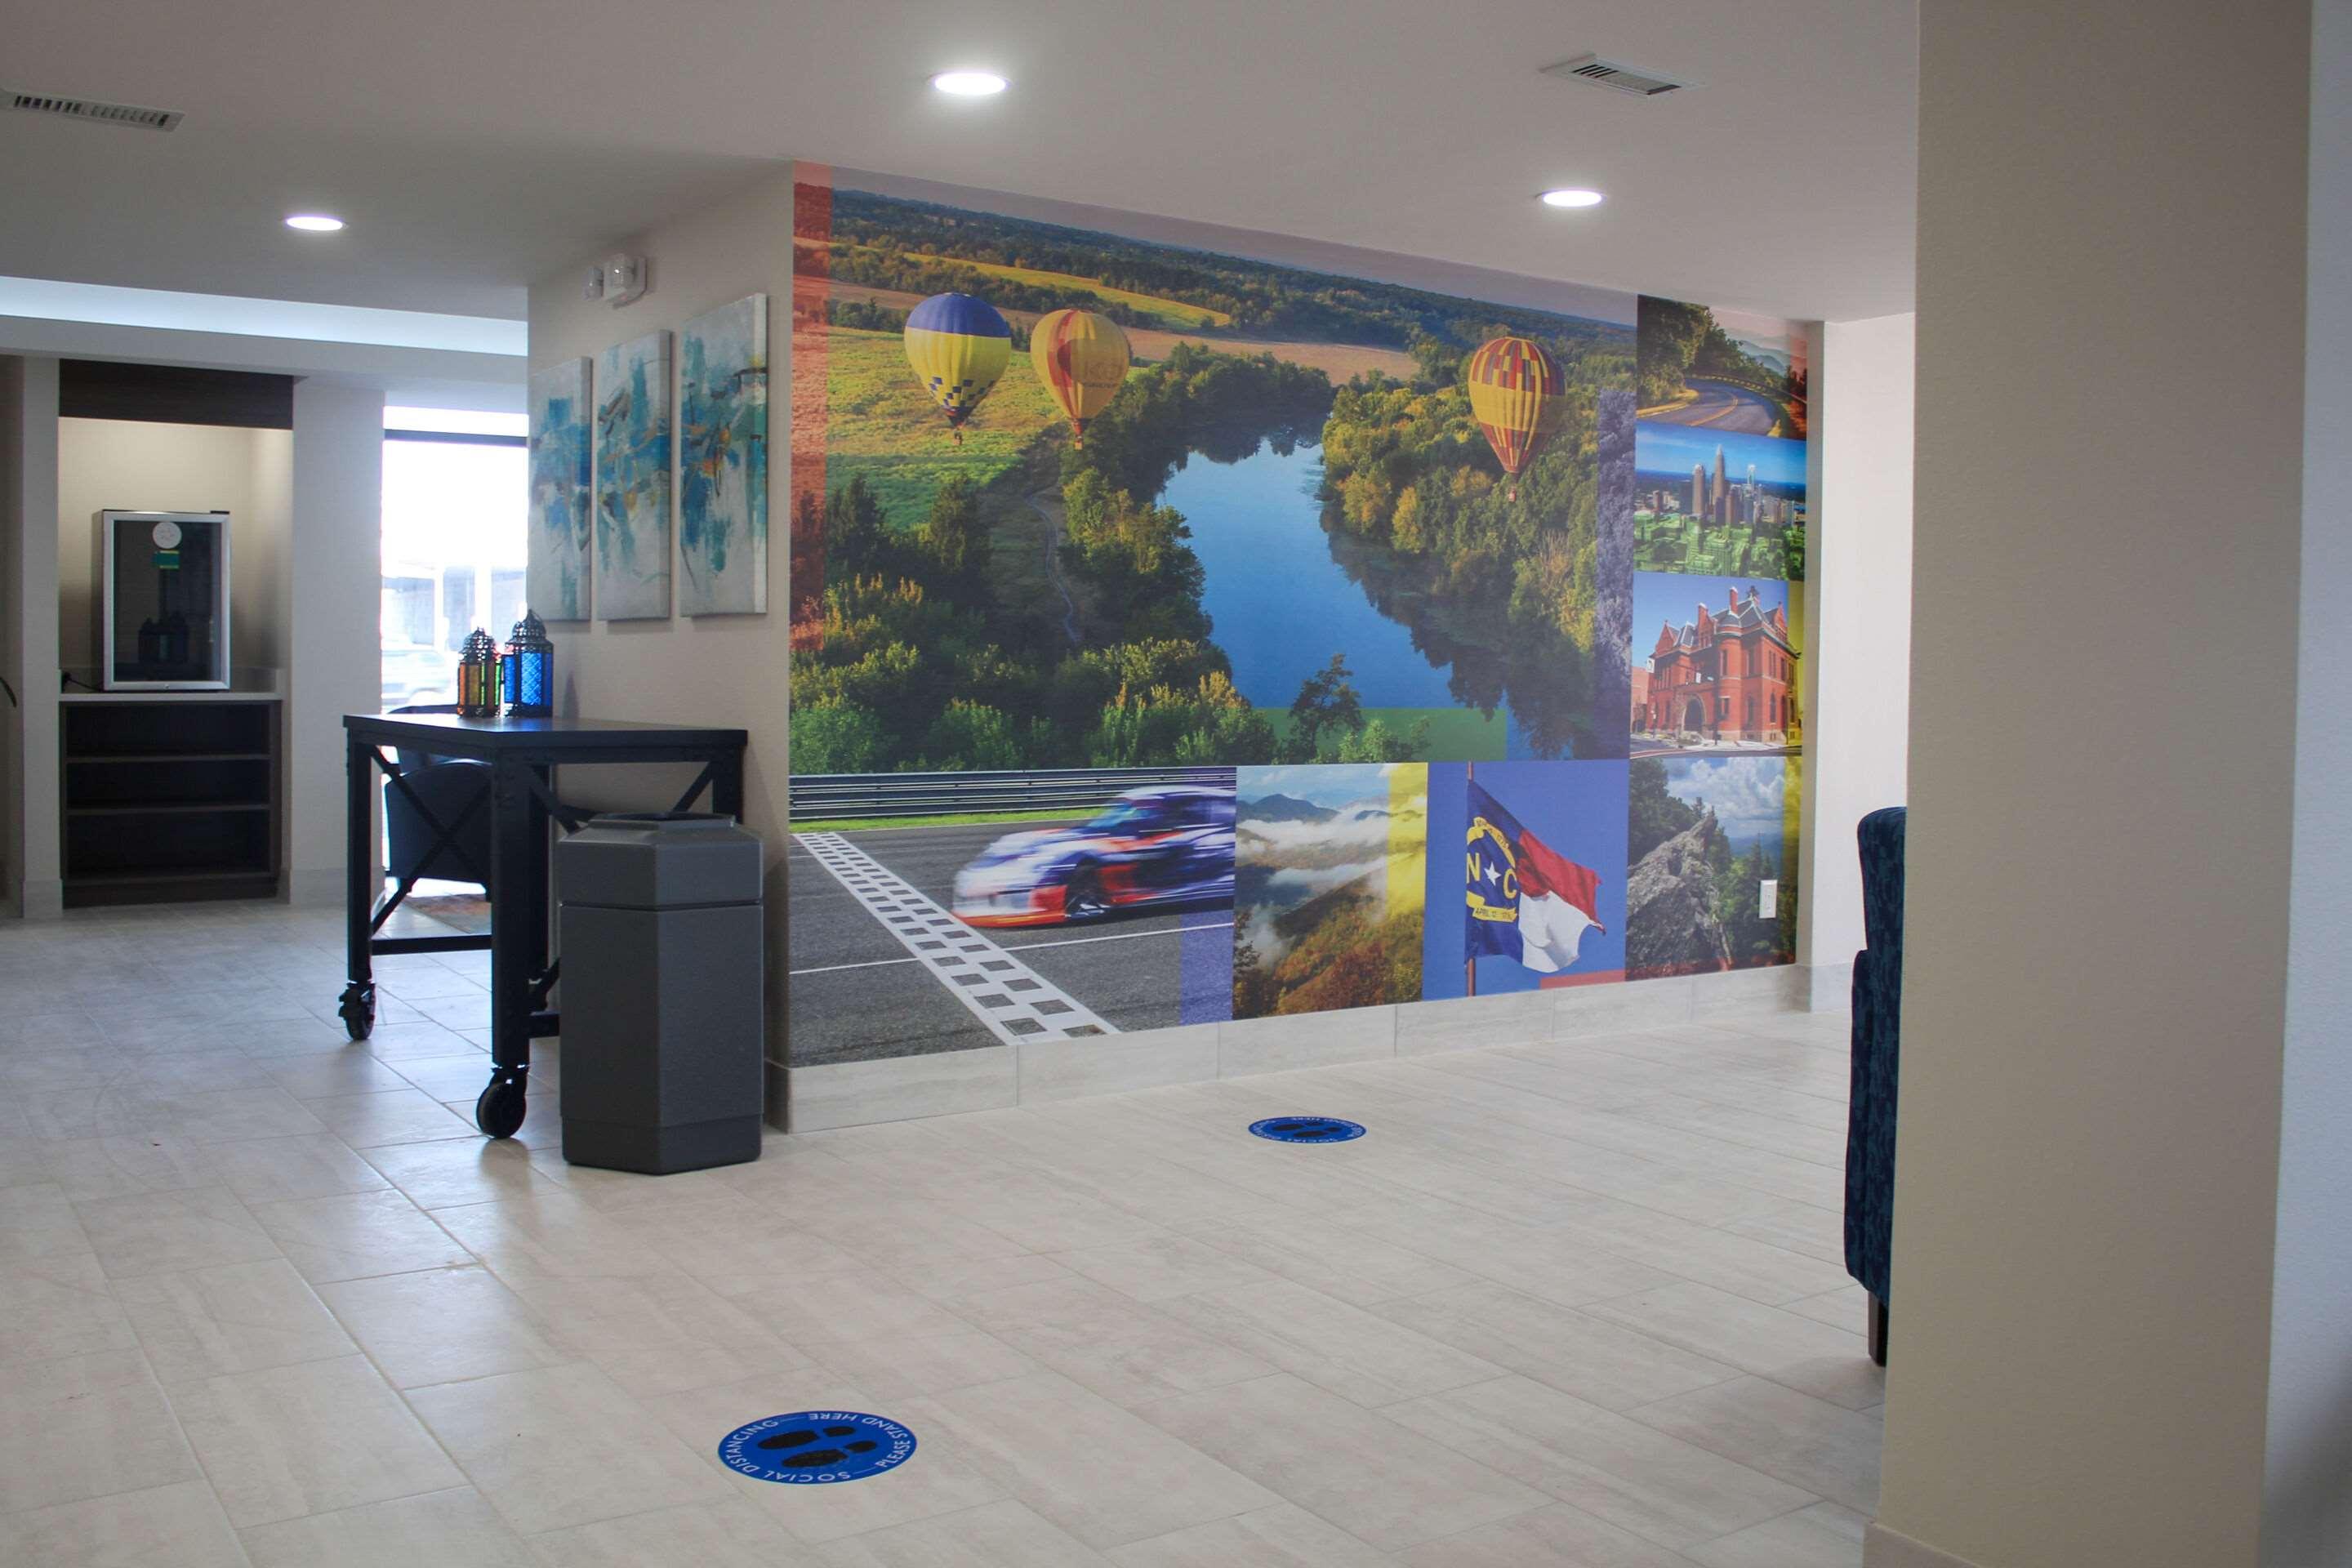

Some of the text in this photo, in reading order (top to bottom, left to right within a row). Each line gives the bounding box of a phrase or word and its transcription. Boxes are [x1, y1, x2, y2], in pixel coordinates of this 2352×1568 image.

[1467, 853, 1517, 899] N C
[725, 1419, 852, 1483] SOCIAL DISTANCING
[808, 1413, 911, 1468] PLEASE STAND HERE
